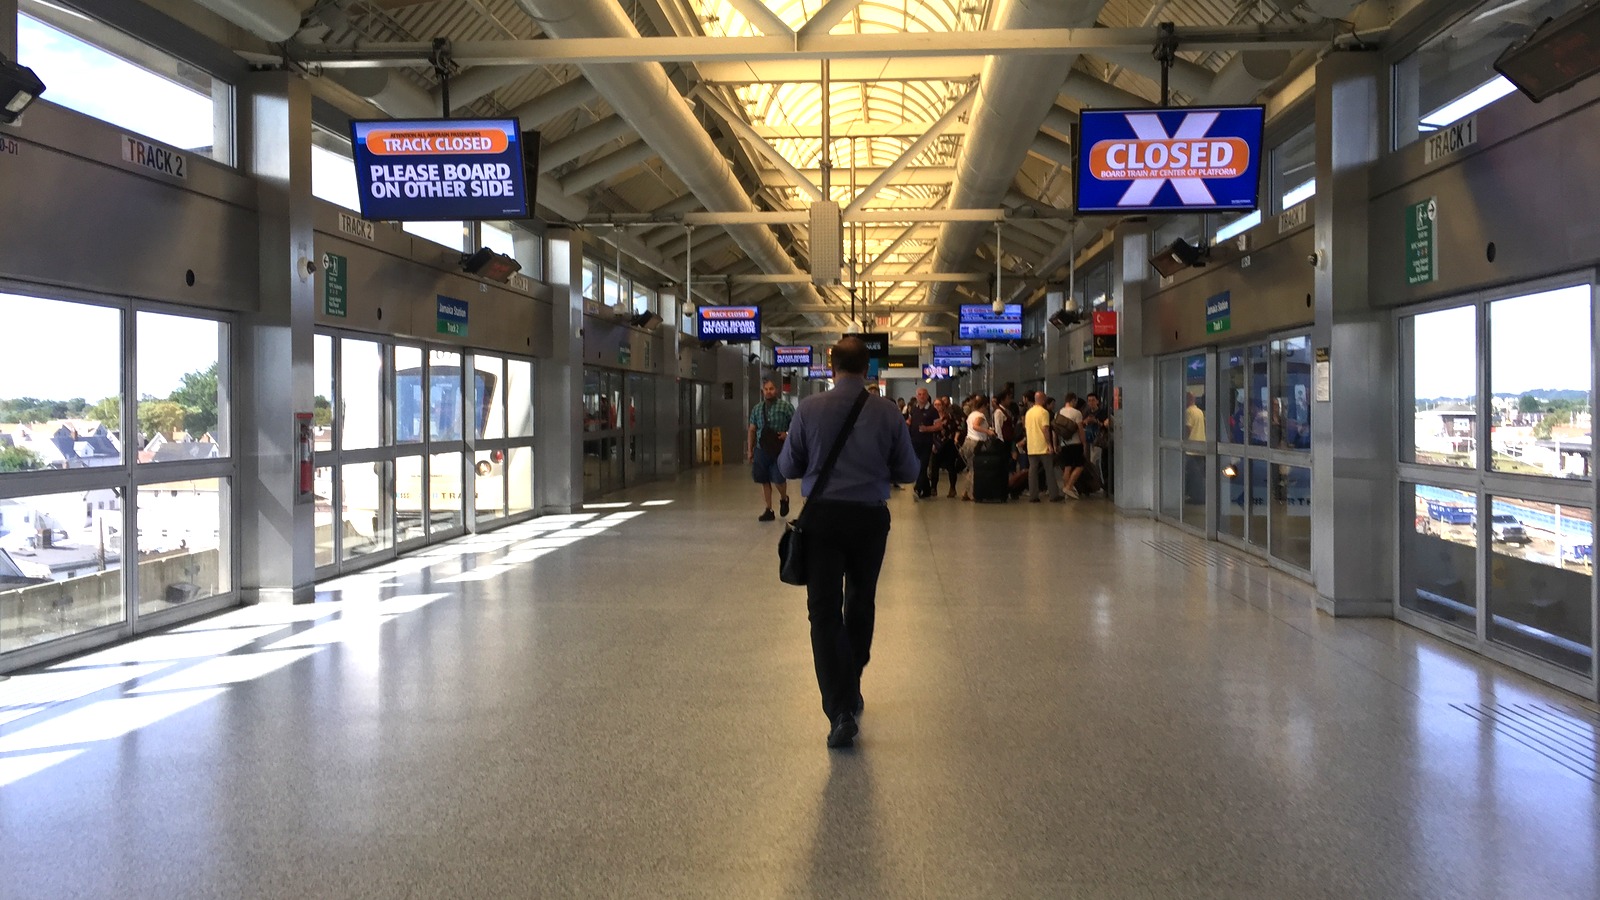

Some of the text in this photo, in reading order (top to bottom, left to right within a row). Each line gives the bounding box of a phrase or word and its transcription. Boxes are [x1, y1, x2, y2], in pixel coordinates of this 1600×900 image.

[383, 137, 492, 152] TRACK CLOSED
[1429, 120, 1472, 158] TRACK 1
[128, 138, 184, 177] TRACK 2
[1105, 142, 1234, 170] CLOSED
[370, 163, 511, 182] PLEASE BOARD
[371, 180, 514, 198] ON OTHER SIDE
[342, 214, 372, 240] TRACK 2
[439, 304, 466, 317] Jamaica Station
